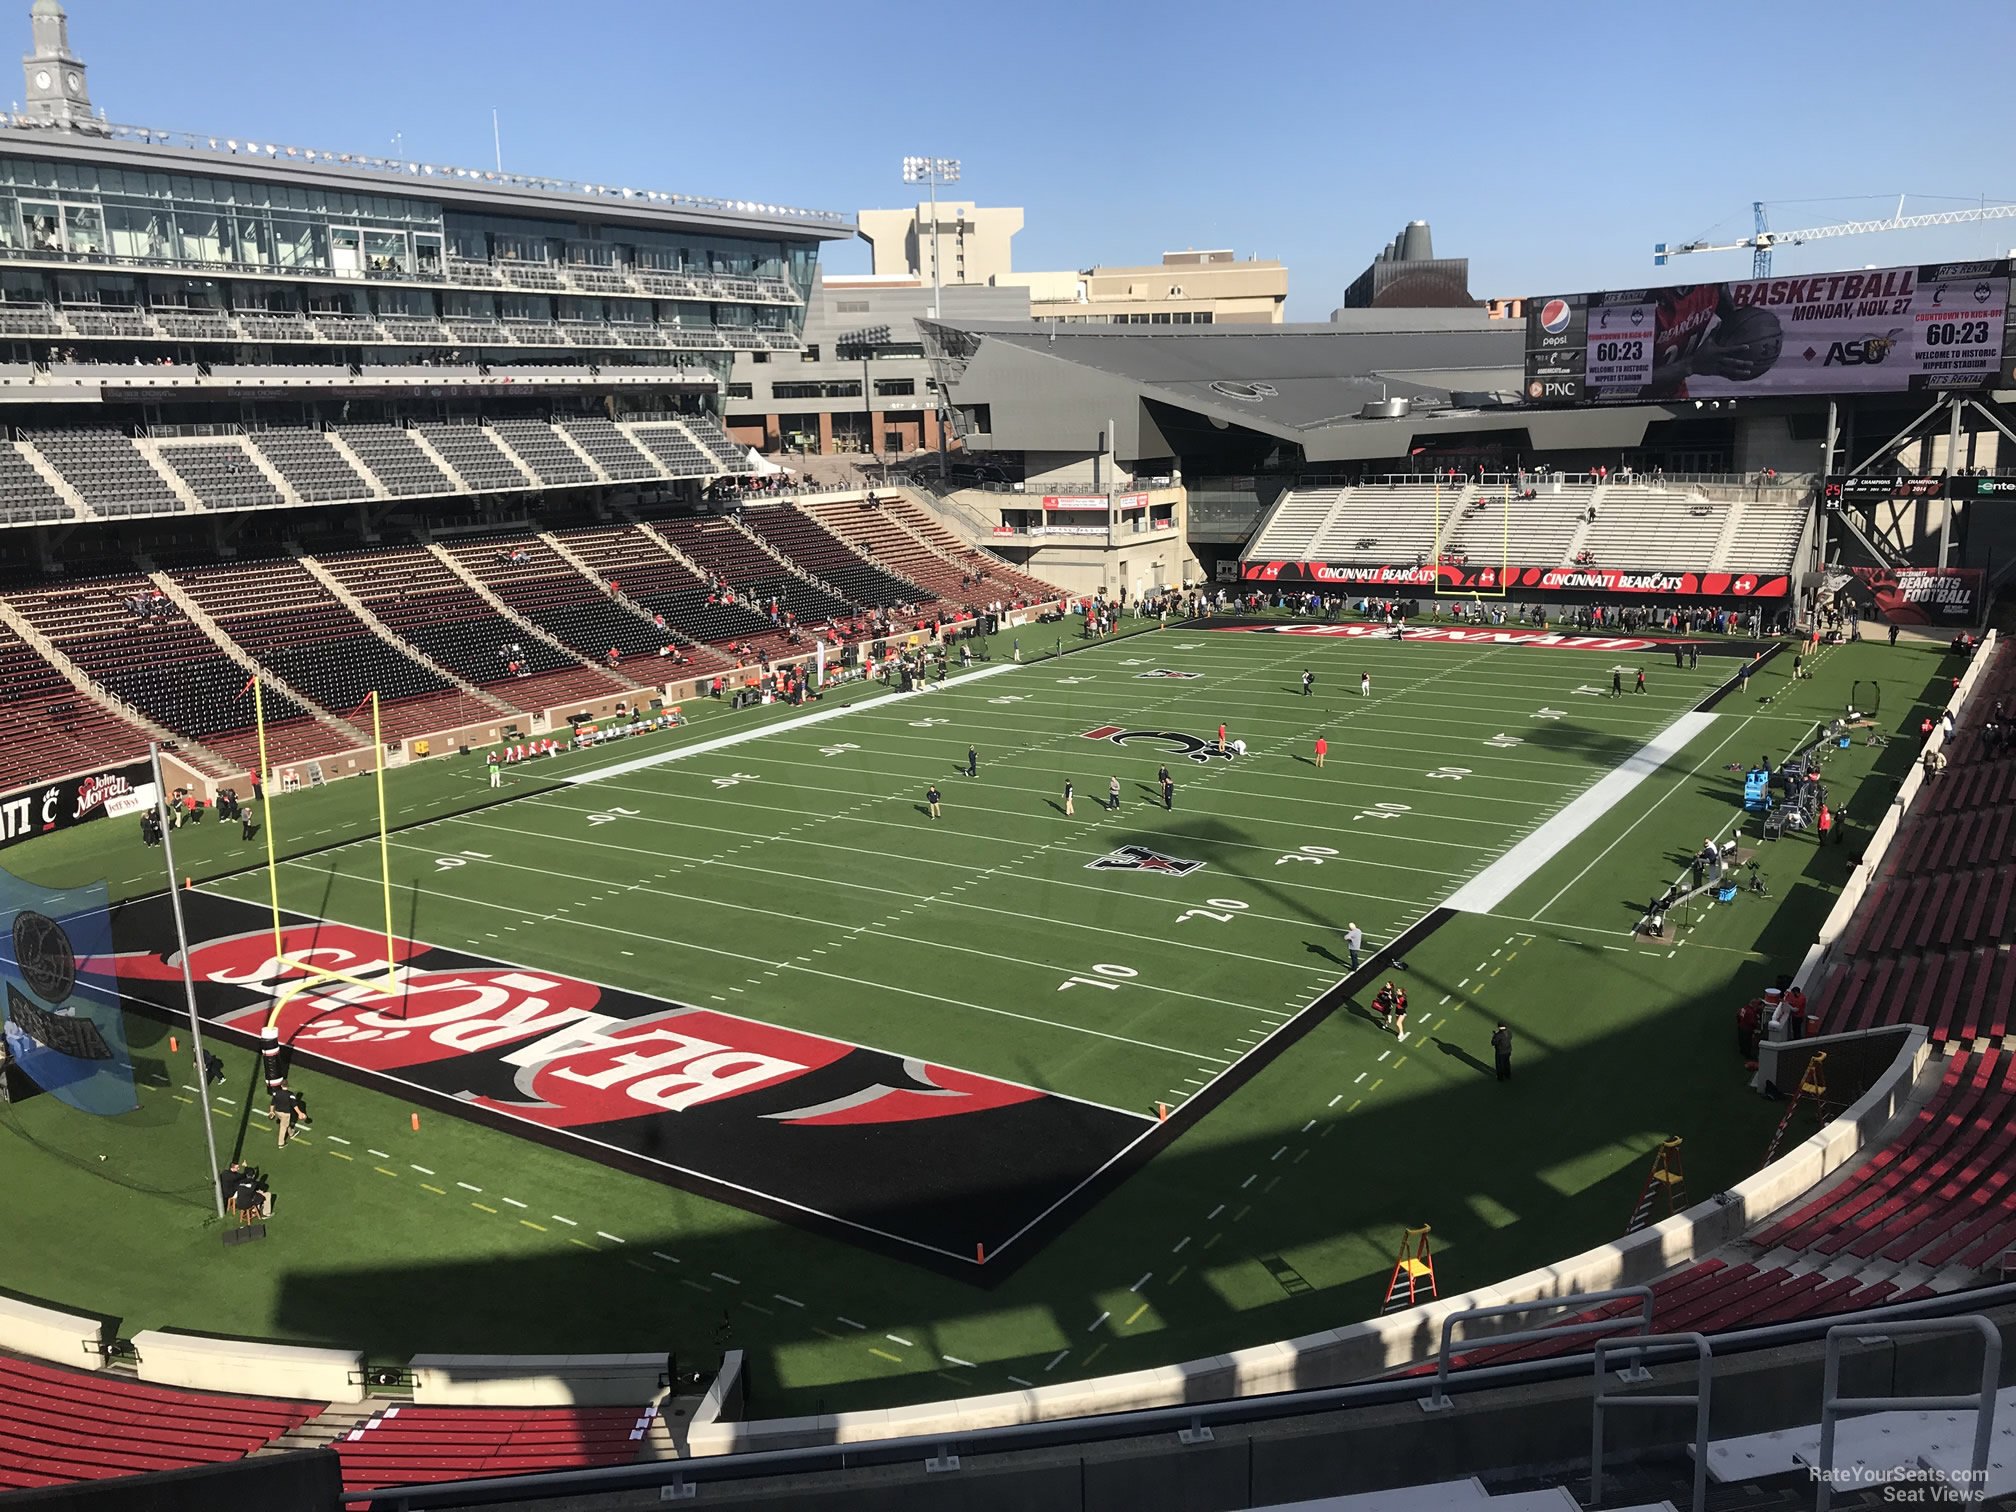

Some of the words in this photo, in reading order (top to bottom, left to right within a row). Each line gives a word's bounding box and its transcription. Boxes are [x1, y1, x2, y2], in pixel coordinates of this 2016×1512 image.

[1733, 271, 1913, 307] BASKETBALL
[1792, 304, 1853, 321] MONDAY,
[1857, 300, 1889, 316] NOV.
[1892, 299, 1912, 315] 27
[1915, 312, 1960, 321] COUNTDOWN
[1961, 311, 1969, 319] TO
[1970, 310, 2003, 319] KICK-OFF
[1656, 305, 1712, 344] BEARCATS
[1926, 321, 1989, 345] 60:23
[1542, 336, 1567, 347] pepsi
[1597, 341, 1643, 361] 60:23
[1823, 341, 1887, 367] ASU
[1915, 350, 1950, 360] WELCOME
[1951, 350, 1960, 358] TO
[1962, 349, 1997, 357] HISTORIC
[1923, 361, 1953, 370] NIPPERT
[1954, 360, 1987, 369] STADIUM
[1545, 382, 1575, 396] PNC
[1825, 484, 1841, 497] 25
[1318, 567, 1379, 581] CINCINNATI
[1382, 566, 1436, 582] BEARCATS
[1543, 572, 1615, 588] CINCINNATI
[1618, 573, 1683, 590] BEARCATS
[1898, 577, 1961, 589] BEARCATS
[1902, 589, 1971, 604] FOOTBALL
[93, 773, 115, 791] John
[1426, 766, 1473, 781] 50
[73, 777, 133, 819] Morrell
[0, 797, 31, 842] TI
[1361, 802, 1412, 819] 40
[1281, 845, 1340, 866] 30
[1185, 898, 1250, 923] 20
[1066, 963, 1139, 991] 10
[206, 947, 811, 1112] BEARCATS
